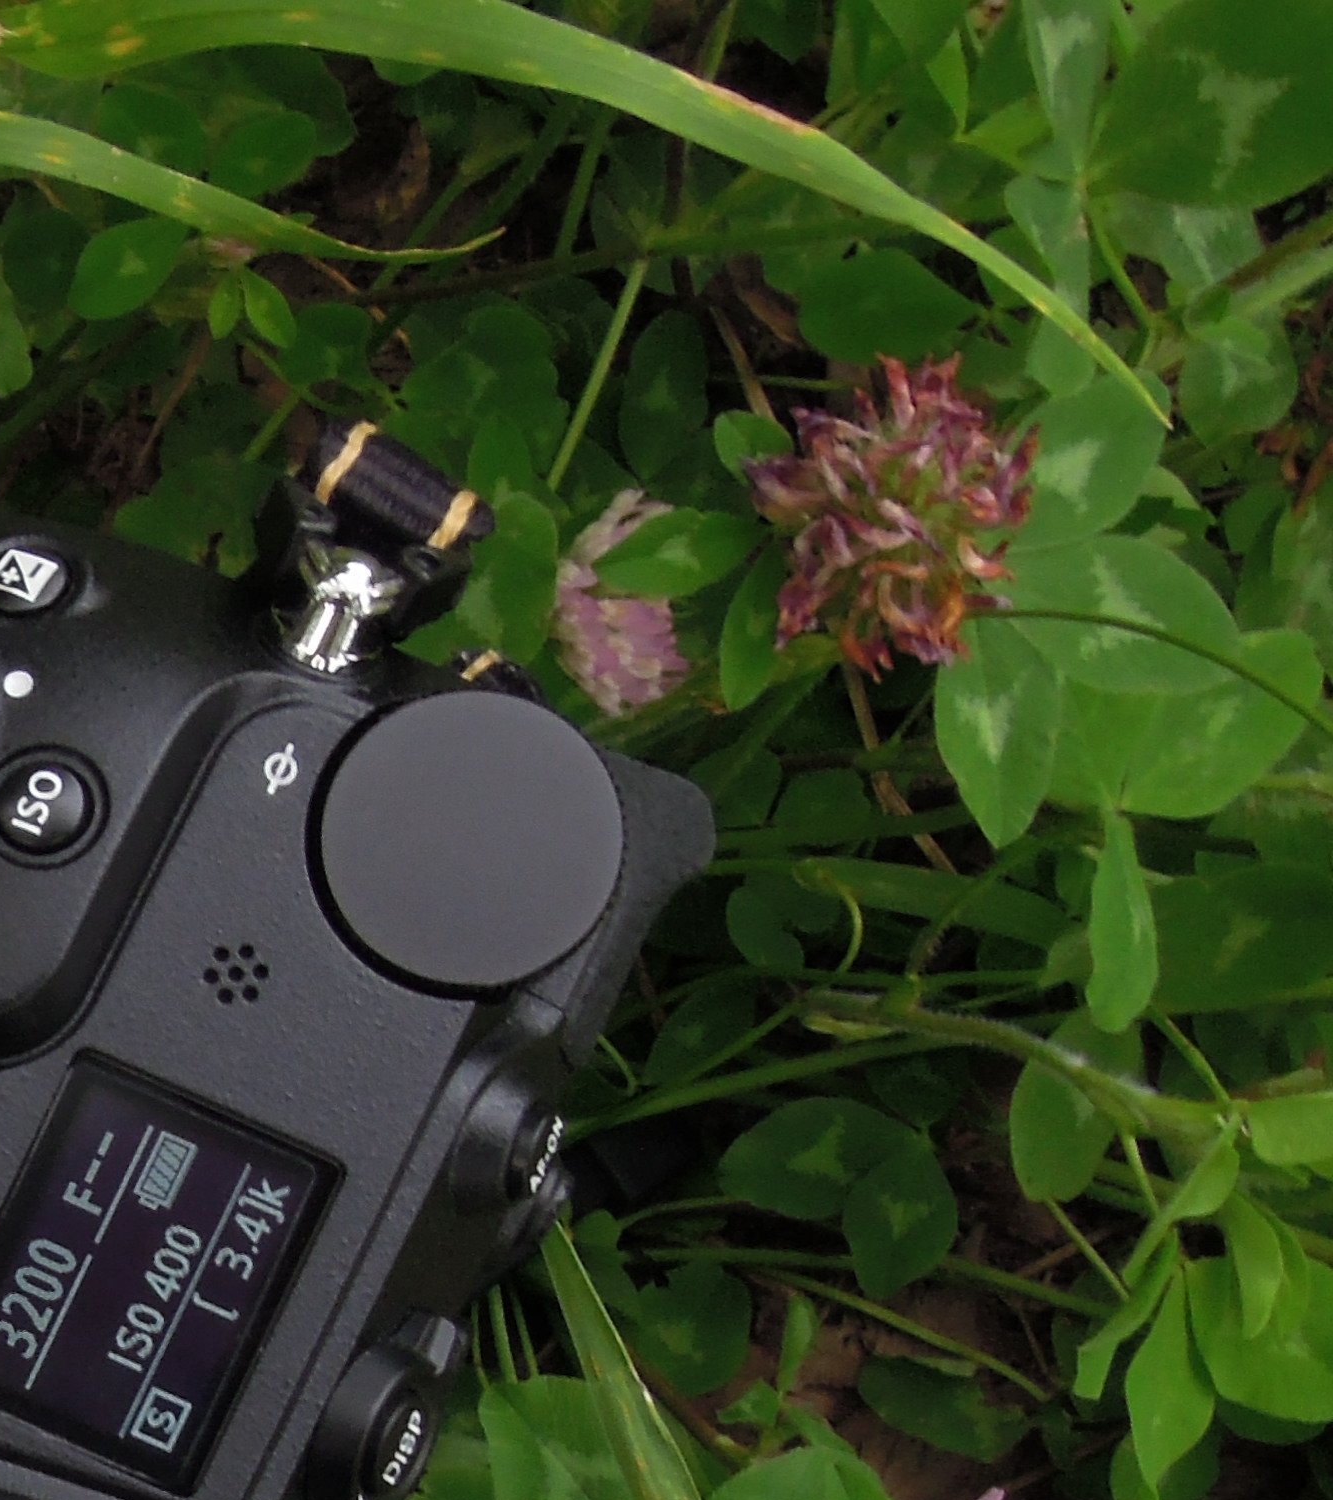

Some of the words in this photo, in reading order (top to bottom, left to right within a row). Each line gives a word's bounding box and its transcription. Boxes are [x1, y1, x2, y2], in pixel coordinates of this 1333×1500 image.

[11, 770, 63, 836] ISO
[108, 1303, 164, 1373] ISO
[144, 1225, 202, 1302] 400
[382, 1410, 422, 1485] DISP
